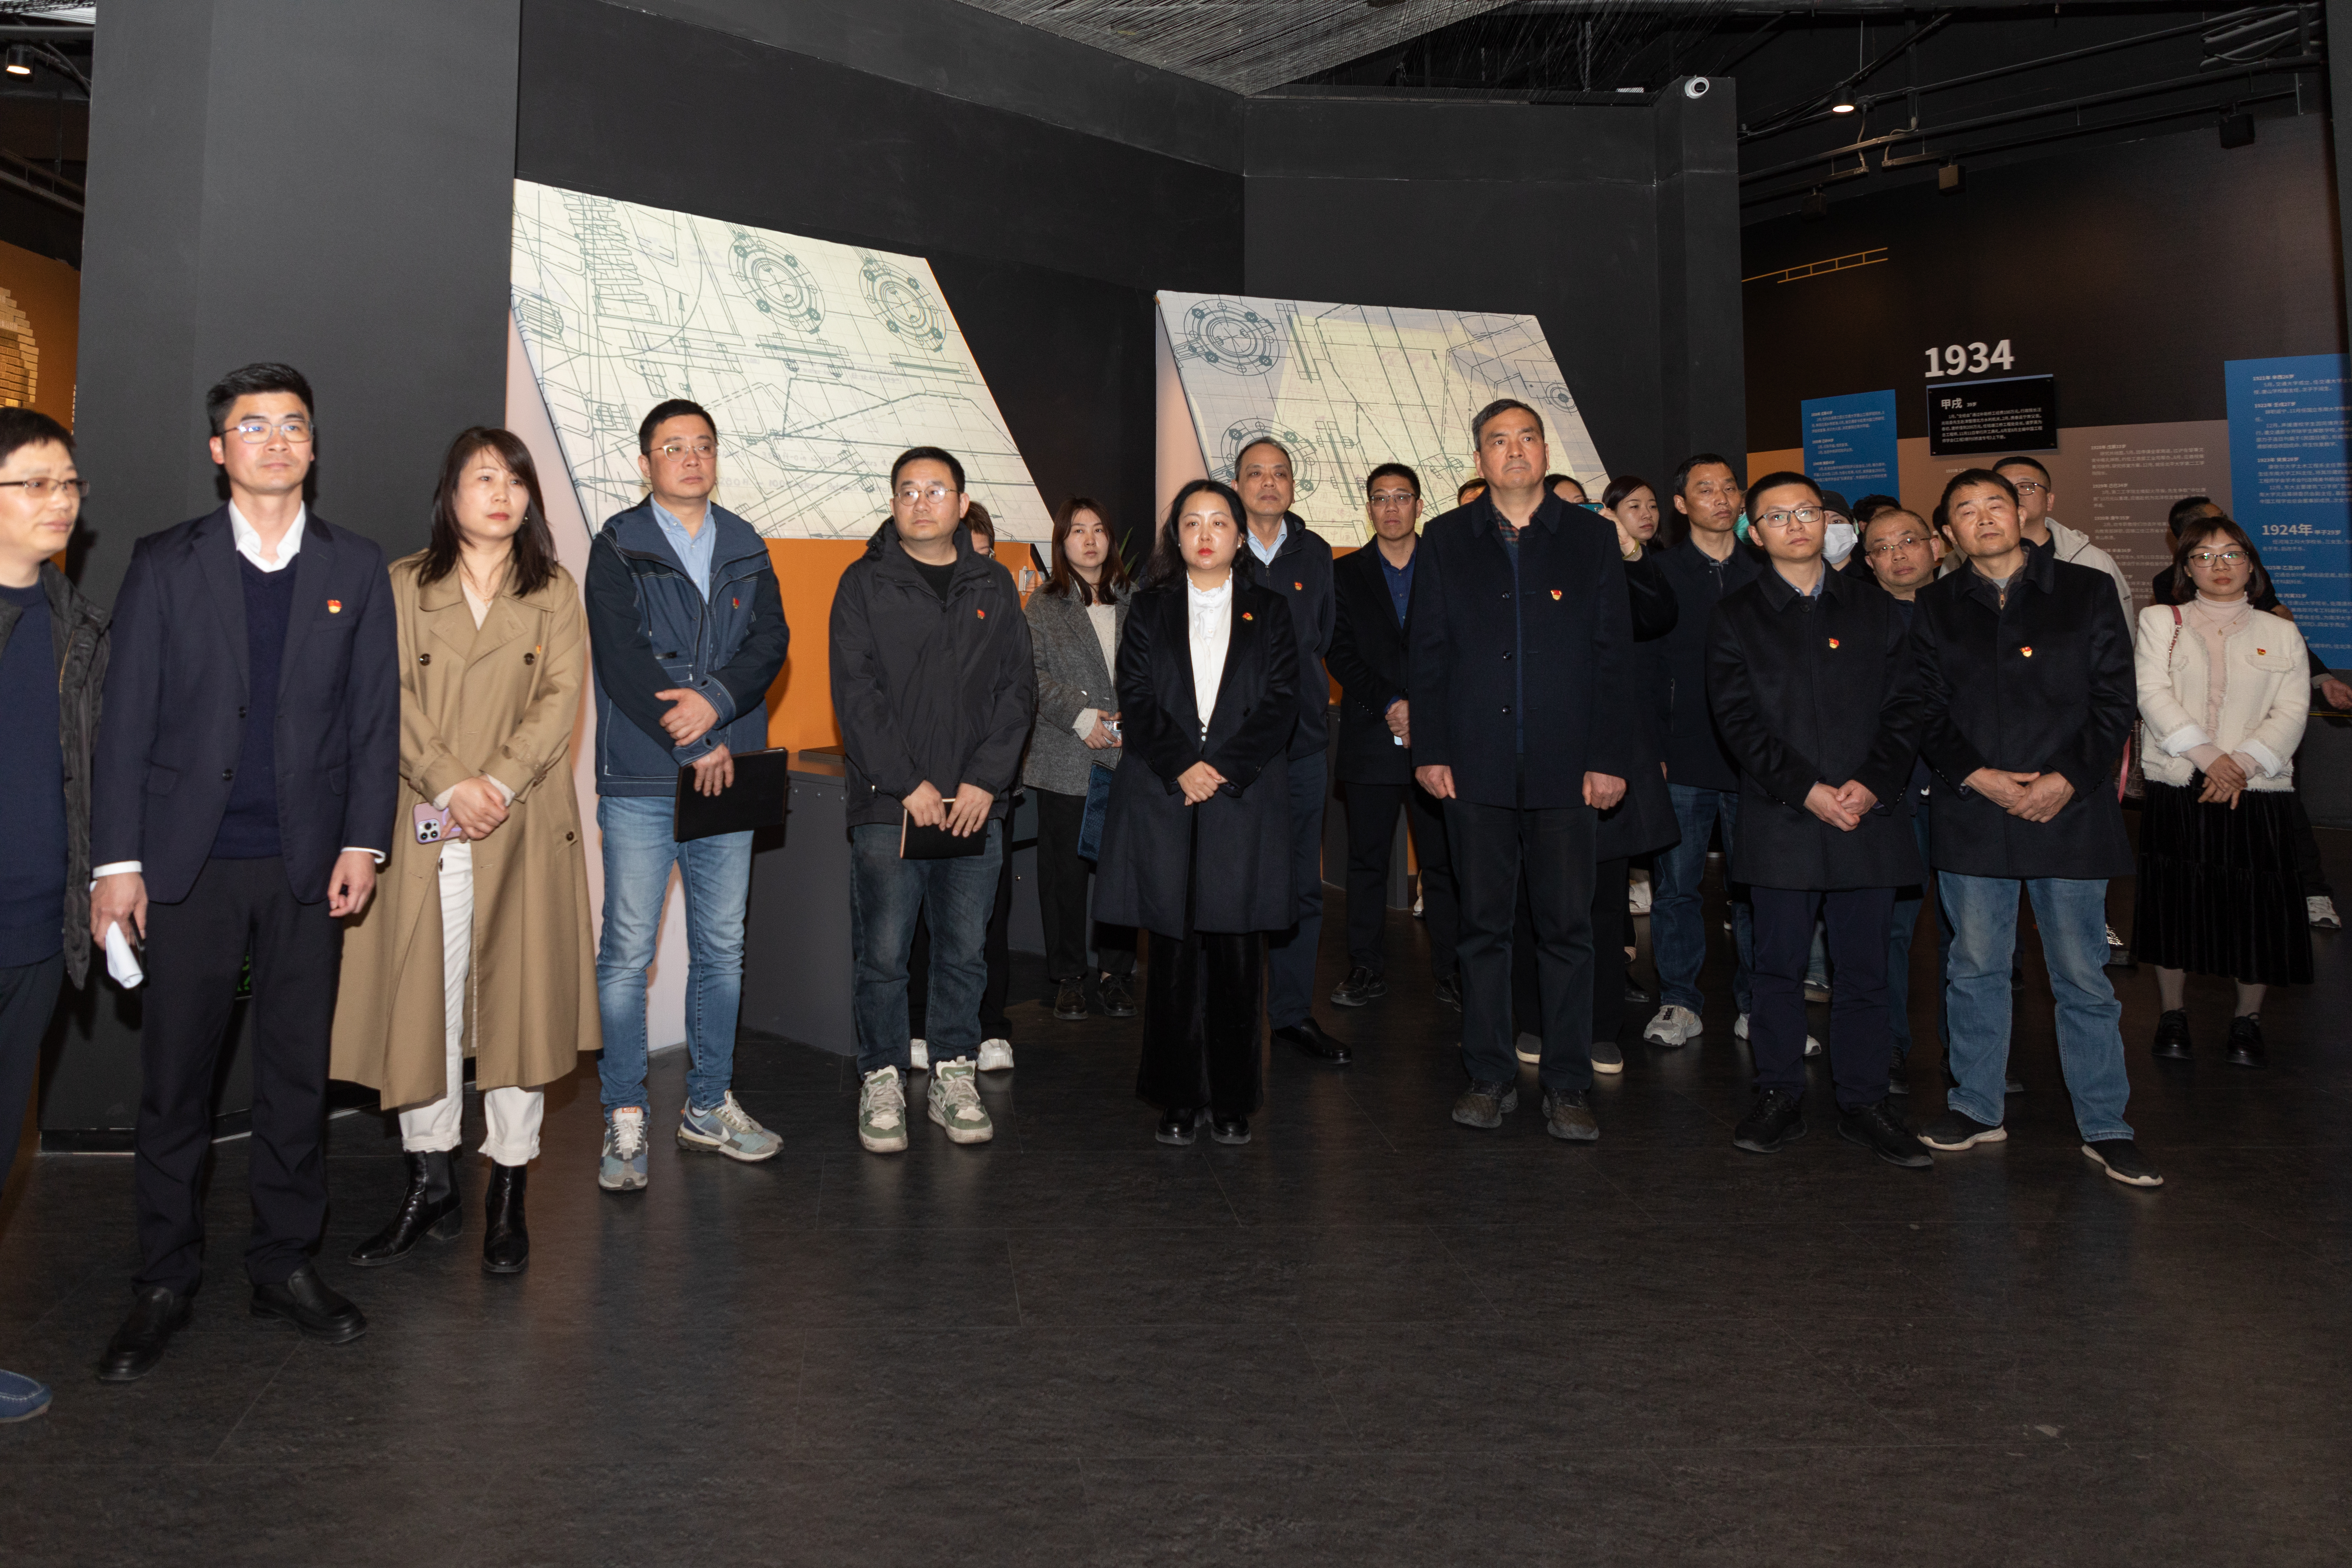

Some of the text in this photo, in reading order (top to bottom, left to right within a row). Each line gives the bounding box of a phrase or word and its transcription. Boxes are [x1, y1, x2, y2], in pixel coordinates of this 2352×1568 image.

[1925, 339, 2015, 377] 1934
[1941, 398, 1962, 410] 甲戌
[2262, 523, 2313, 536] 1924年
